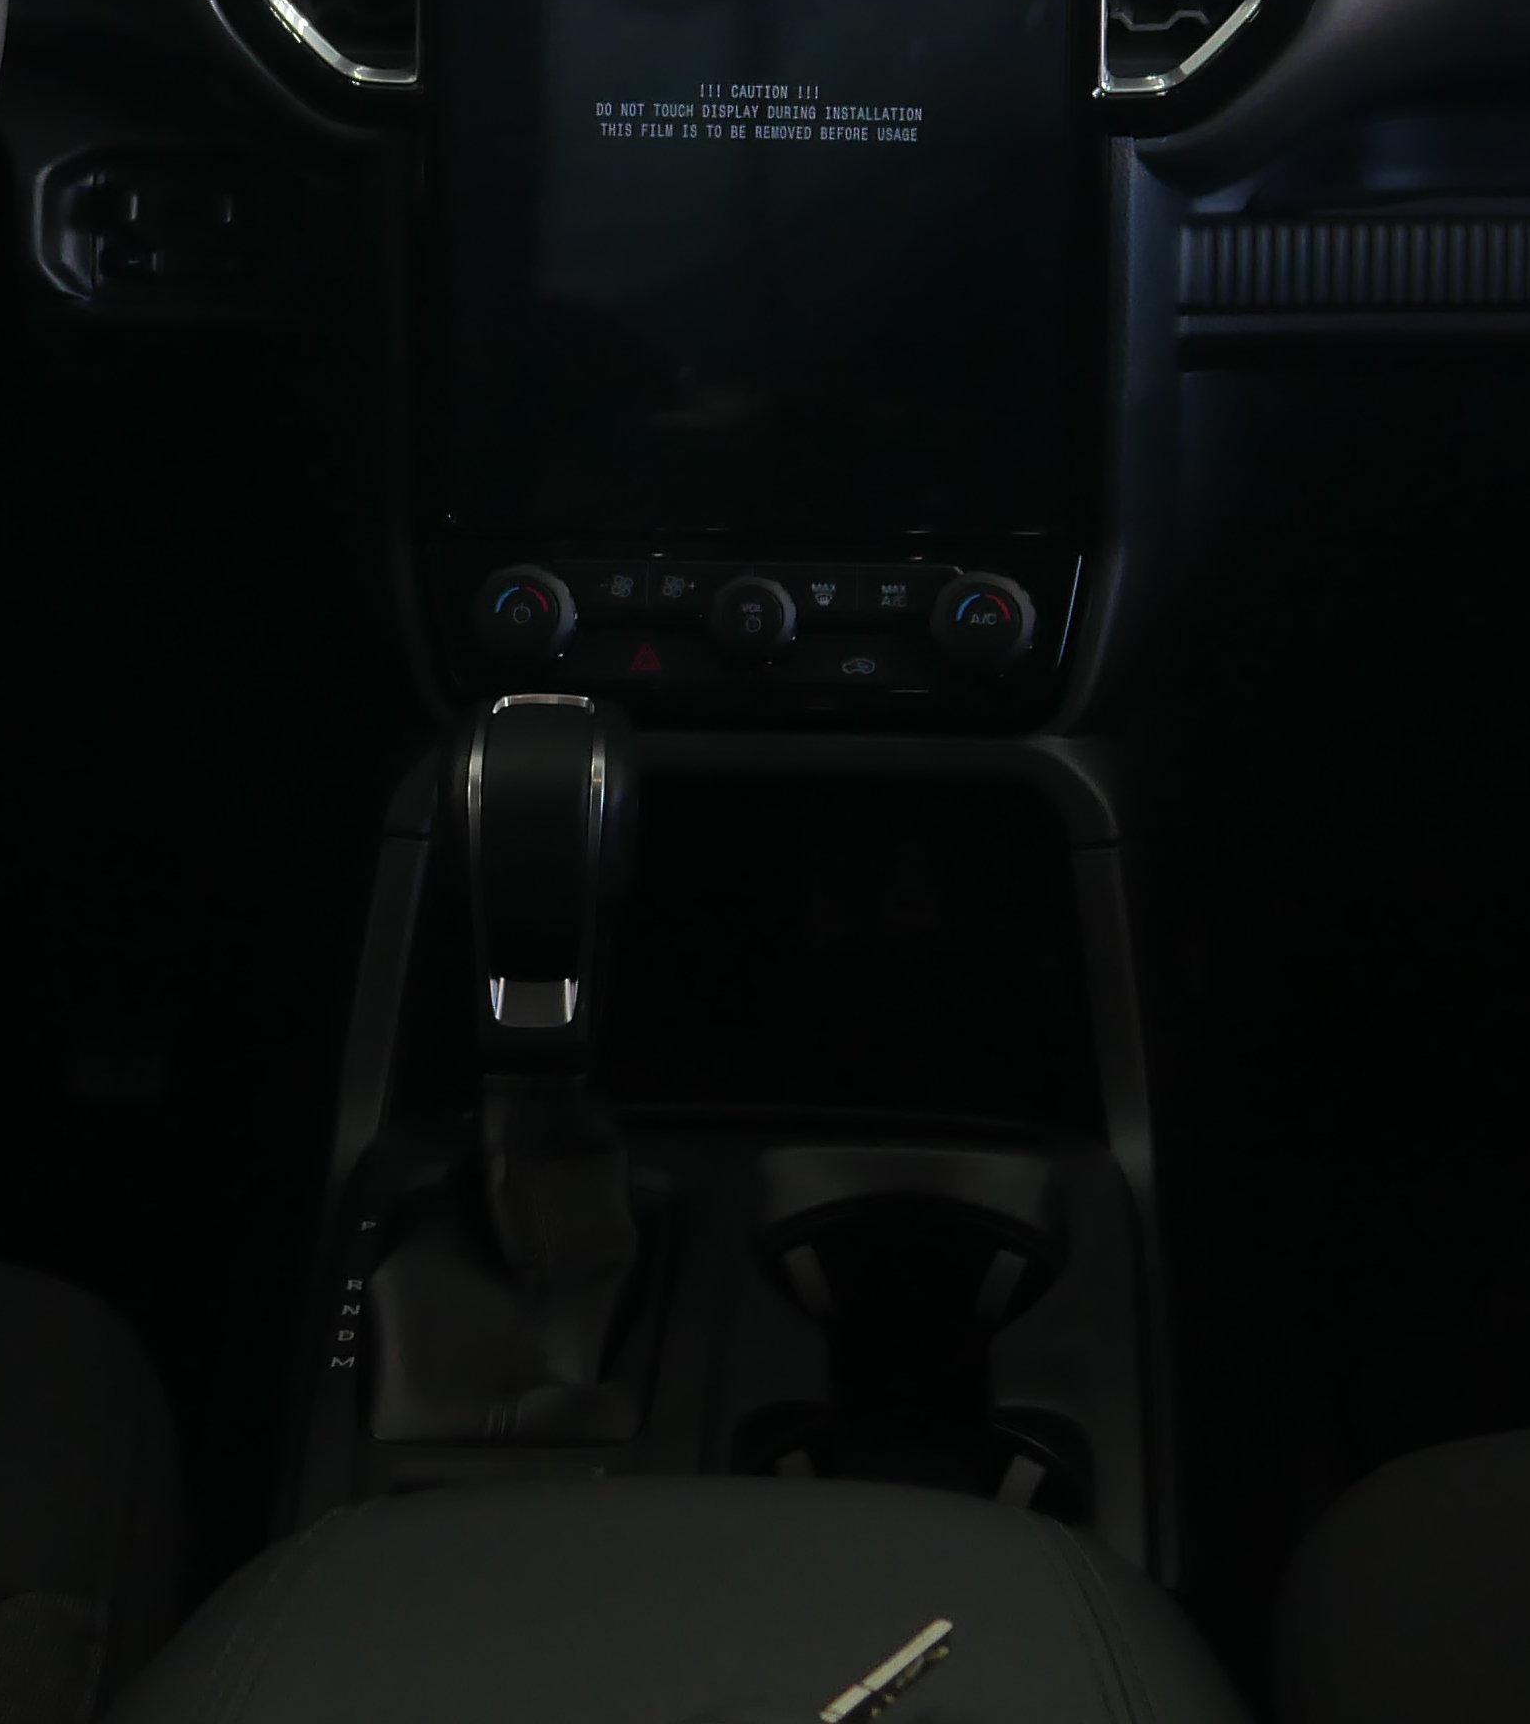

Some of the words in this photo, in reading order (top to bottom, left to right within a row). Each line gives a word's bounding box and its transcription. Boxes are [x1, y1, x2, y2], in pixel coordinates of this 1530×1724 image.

[700, 84, 721, 98] !!!
[730, 84, 789, 99] CAUTION
[798, 85, 819, 99] !!!
[596, 103, 613, 117] DO
[621, 103, 644, 117] NOT
[653, 103, 694, 118] TOUCH
[702, 104, 759, 119] DISPLAY
[767, 105, 816, 120] DURING
[825, 106, 923, 121] INSTALLATION
[600, 123, 632, 137] THIS
[641, 124, 673, 137] FILM
[683, 124, 698, 138] IS
[706, 125, 722, 139] TO
[730, 125, 746, 139] BE
[755, 125, 812, 140] REMOVED
[820, 126, 869, 141] BEFORE
[877, 127, 918, 142] USAGE
[810, 582, 837, 592] MAX
[880, 583, 907, 593] MAX
[741, 604, 763, 614] VOL
[970, 612, 998, 625] A/C
[360, 1221, 376, 1231] P
[346, 1279, 363, 1291] R
[341, 1304, 361, 1316] N
[337, 1330, 354, 1341] D
[331, 1356, 355, 1368] M
